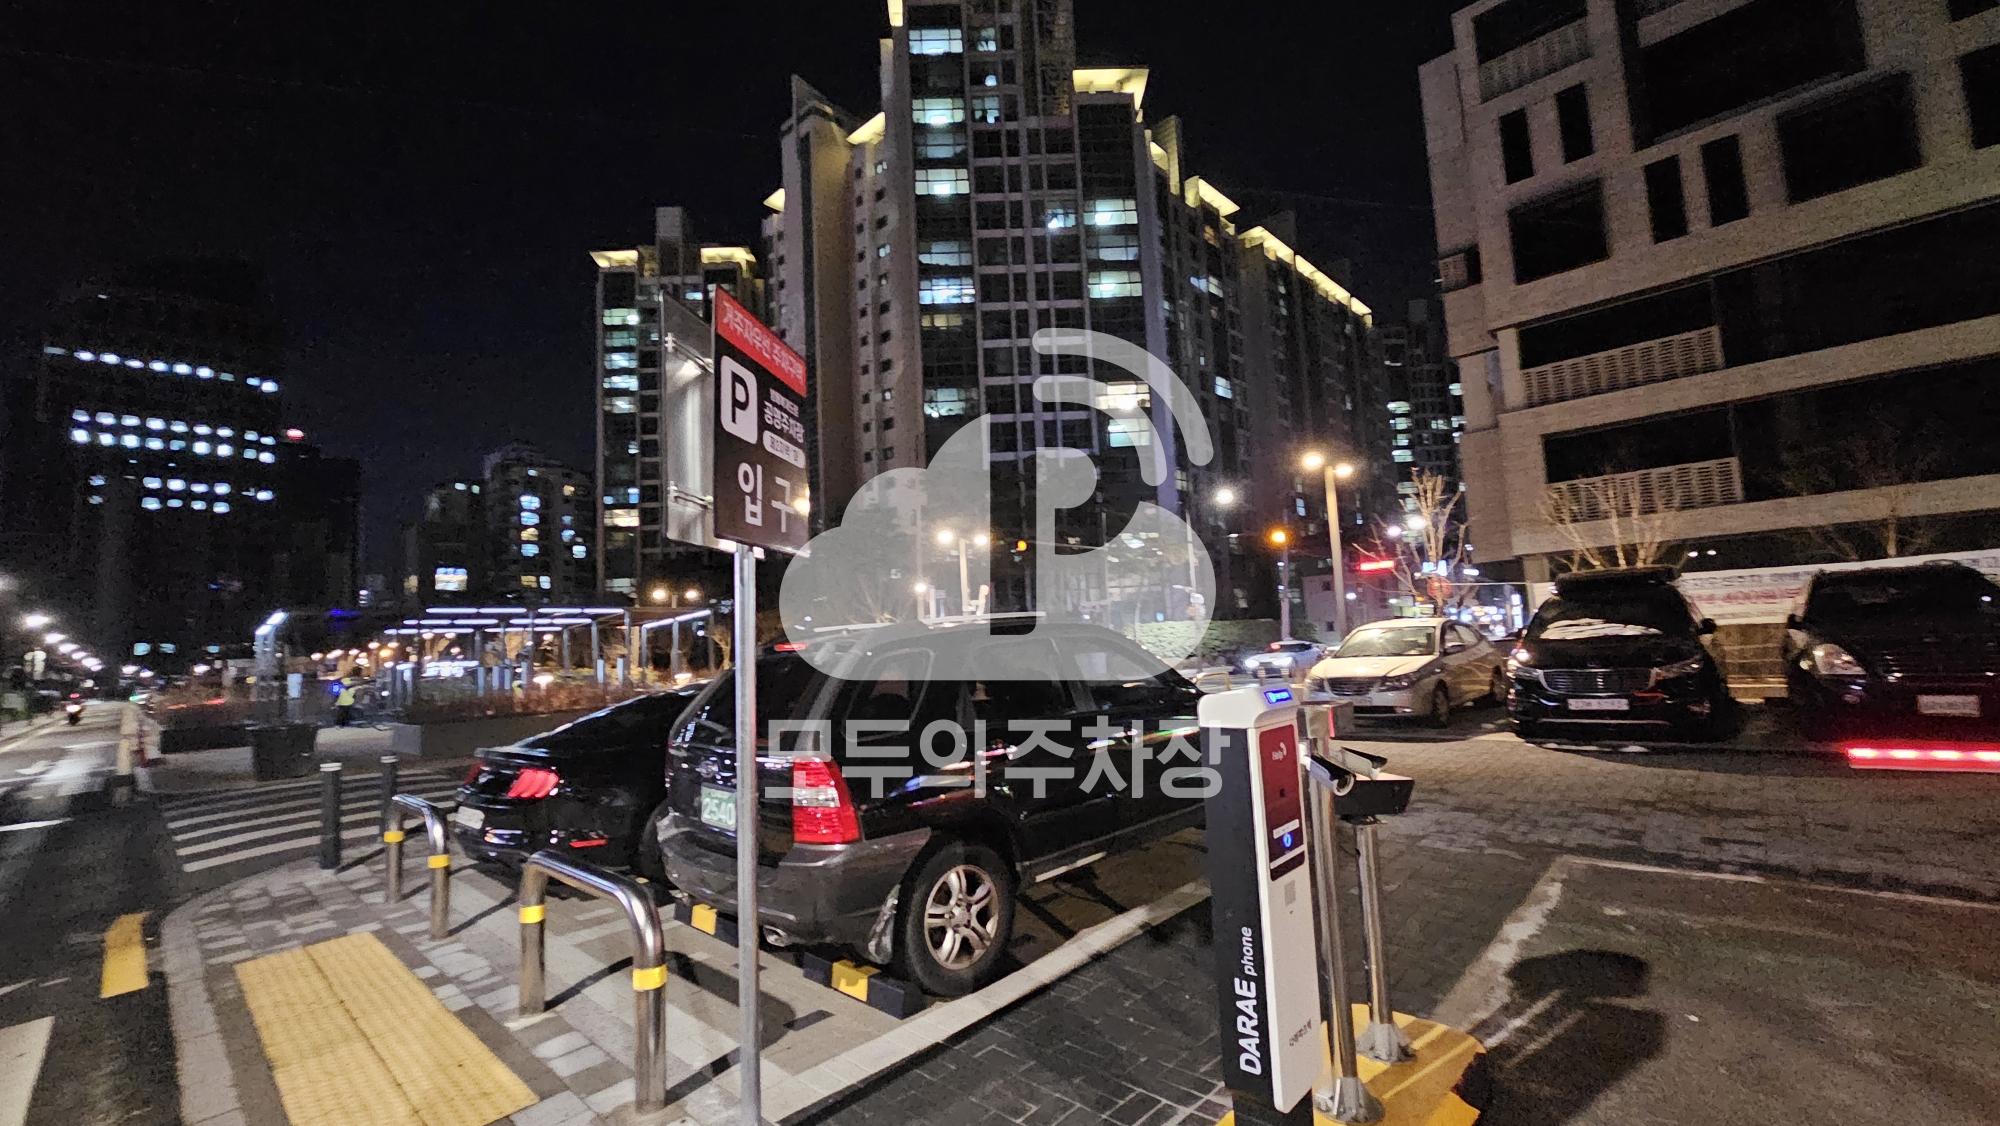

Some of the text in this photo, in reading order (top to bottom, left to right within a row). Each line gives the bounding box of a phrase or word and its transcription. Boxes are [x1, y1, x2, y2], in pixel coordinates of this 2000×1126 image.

[731, 370, 750, 425] P
[763, 399, 806, 444] 공영주차장
[1234, 926, 1263, 1076] DARAE phone
